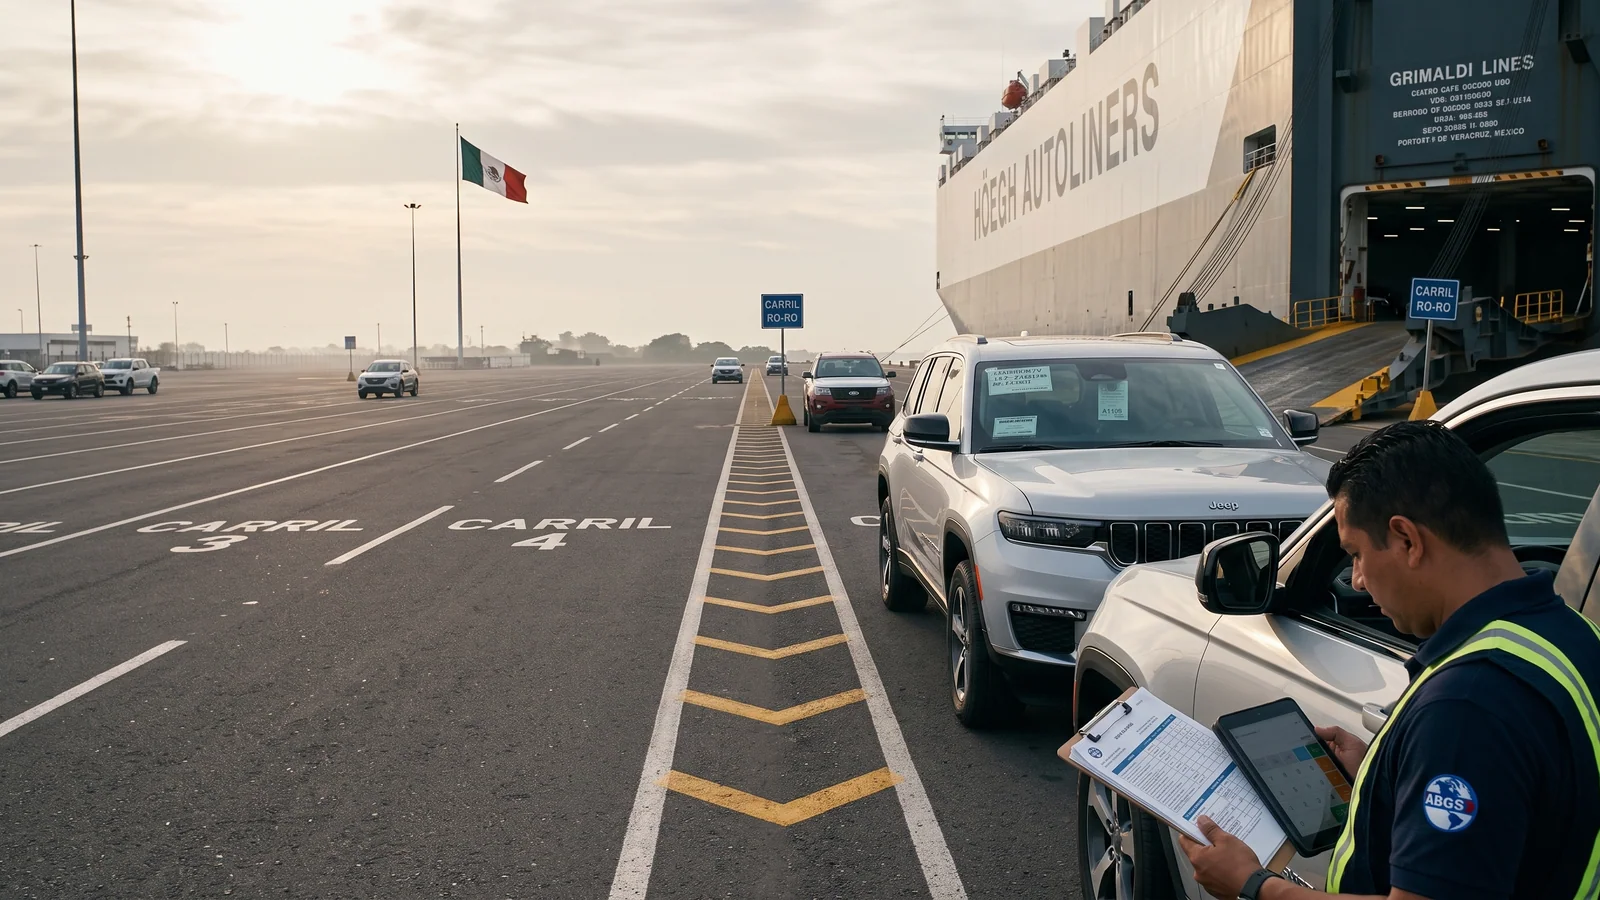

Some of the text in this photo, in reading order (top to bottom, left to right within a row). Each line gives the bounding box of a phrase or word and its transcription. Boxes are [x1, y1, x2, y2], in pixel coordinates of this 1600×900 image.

[1389, 54, 1534, 87] GRIMALDI LINES
[1450, 130, 1492, 142] VERACRUZ,
[974, 62, 1159, 241] HÖEGH AUTOLINERS
[1415, 285, 1454, 298] CARRIL
[764, 300, 800, 309] CARRIL
[1416, 301, 1451, 313] RO-RO
[767, 313, 798, 322] RO-RO
[1209, 501, 1239, 511] Jeep
[136, 519, 364, 533] CARRIL
[448, 517, 672, 530] CARRIL
[169, 534, 248, 553] 3
[510, 532, 567, 550] 4
[1425, 793, 1464, 811] ABGS
